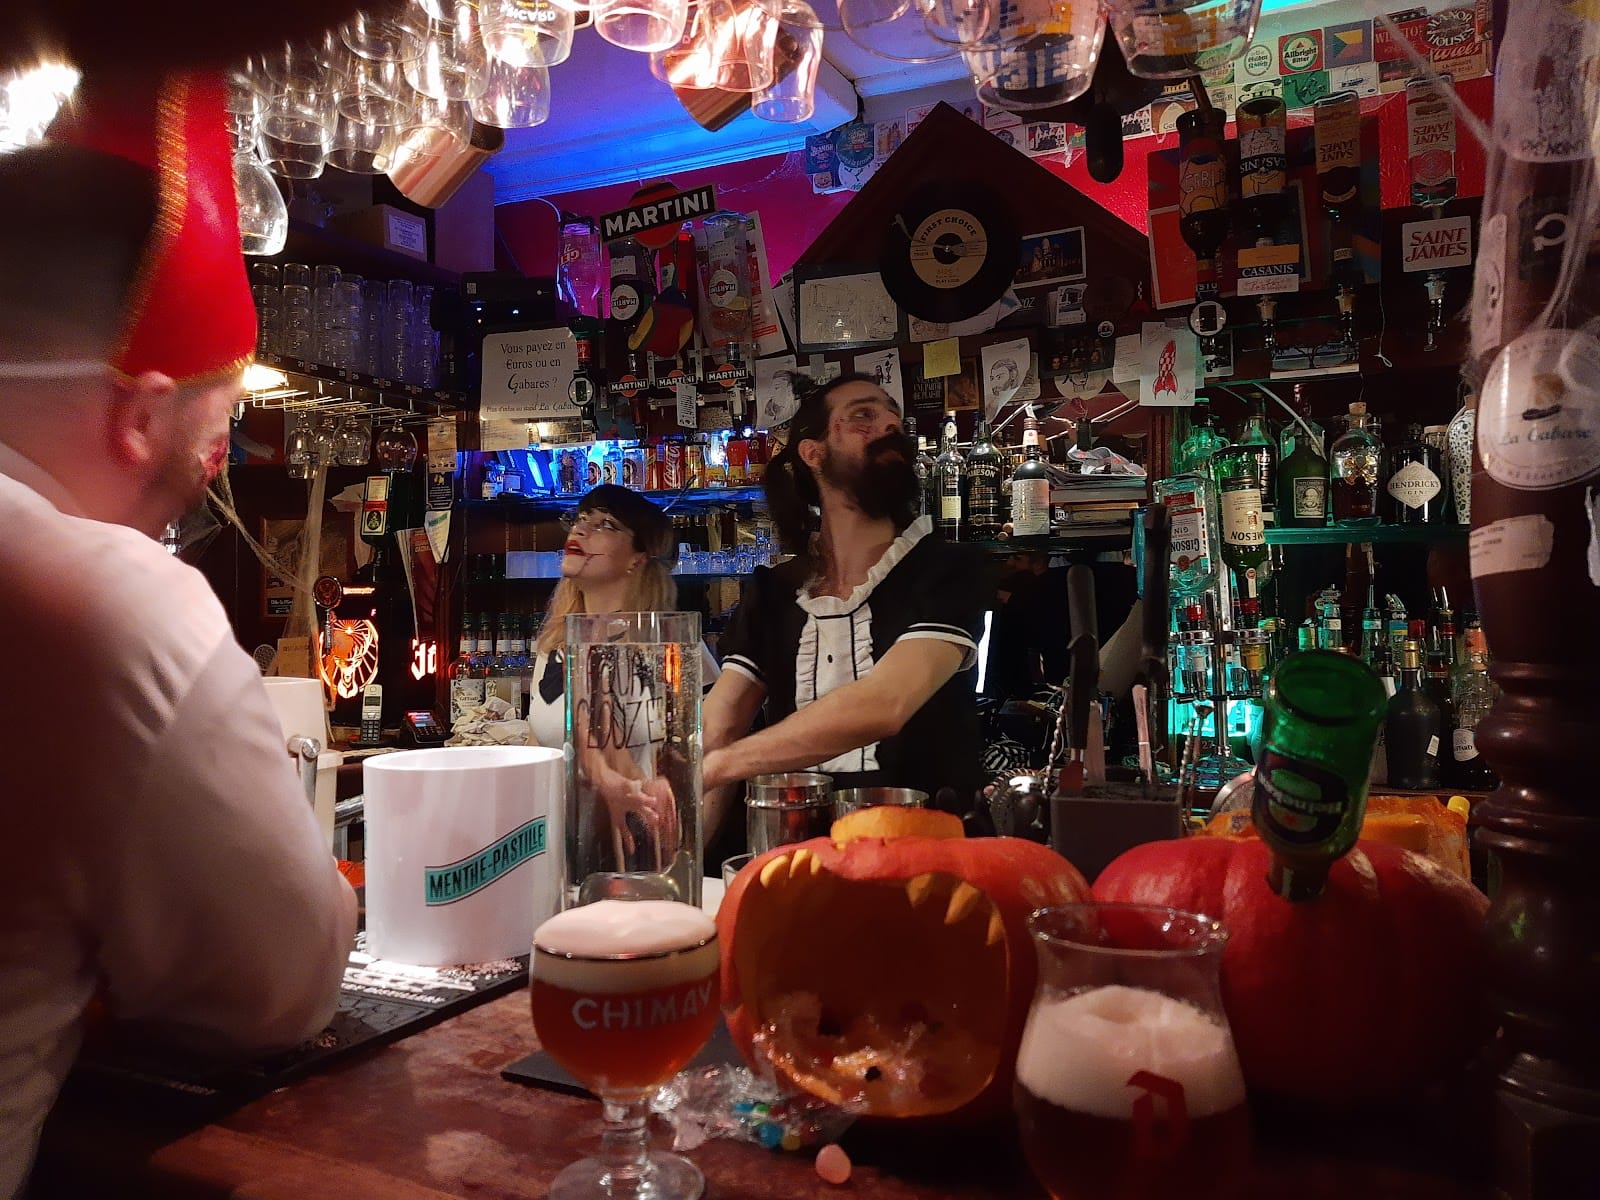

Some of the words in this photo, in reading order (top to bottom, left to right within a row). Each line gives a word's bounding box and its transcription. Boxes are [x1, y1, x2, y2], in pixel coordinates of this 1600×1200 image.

[1413, 121, 1453, 136] JAMES
[1414, 132, 1450, 145] SAINT
[1320, 138, 1357, 154] JAMES
[1322, 150, 1354, 163] SAINT
[604, 191, 710, 236] MARTINI
[921, 218, 942, 241] FIRST
[945, 216, 977, 237] CHOICE
[1411, 228, 1467, 245] SAINT
[1405, 243, 1467, 262] JAMES
[1242, 264, 1294, 278] CASANIS
[500, 343, 523, 354] Vous
[526, 342, 553, 355] payez
[555, 342, 566, 351] en
[550, 358, 561, 367] en
[658, 376, 695, 387] MARTINI
[708, 370, 745, 381] MARTINI
[507, 373, 550, 394] Gabares
[611, 380, 647, 391] MARTINI
[1174, 526, 1189, 534] GIN
[1170, 538, 1200, 552] GIBSON
[430, 824, 544, 898] MENTHE-PASTILLE
[572, 979, 714, 1030] CHIMAY
